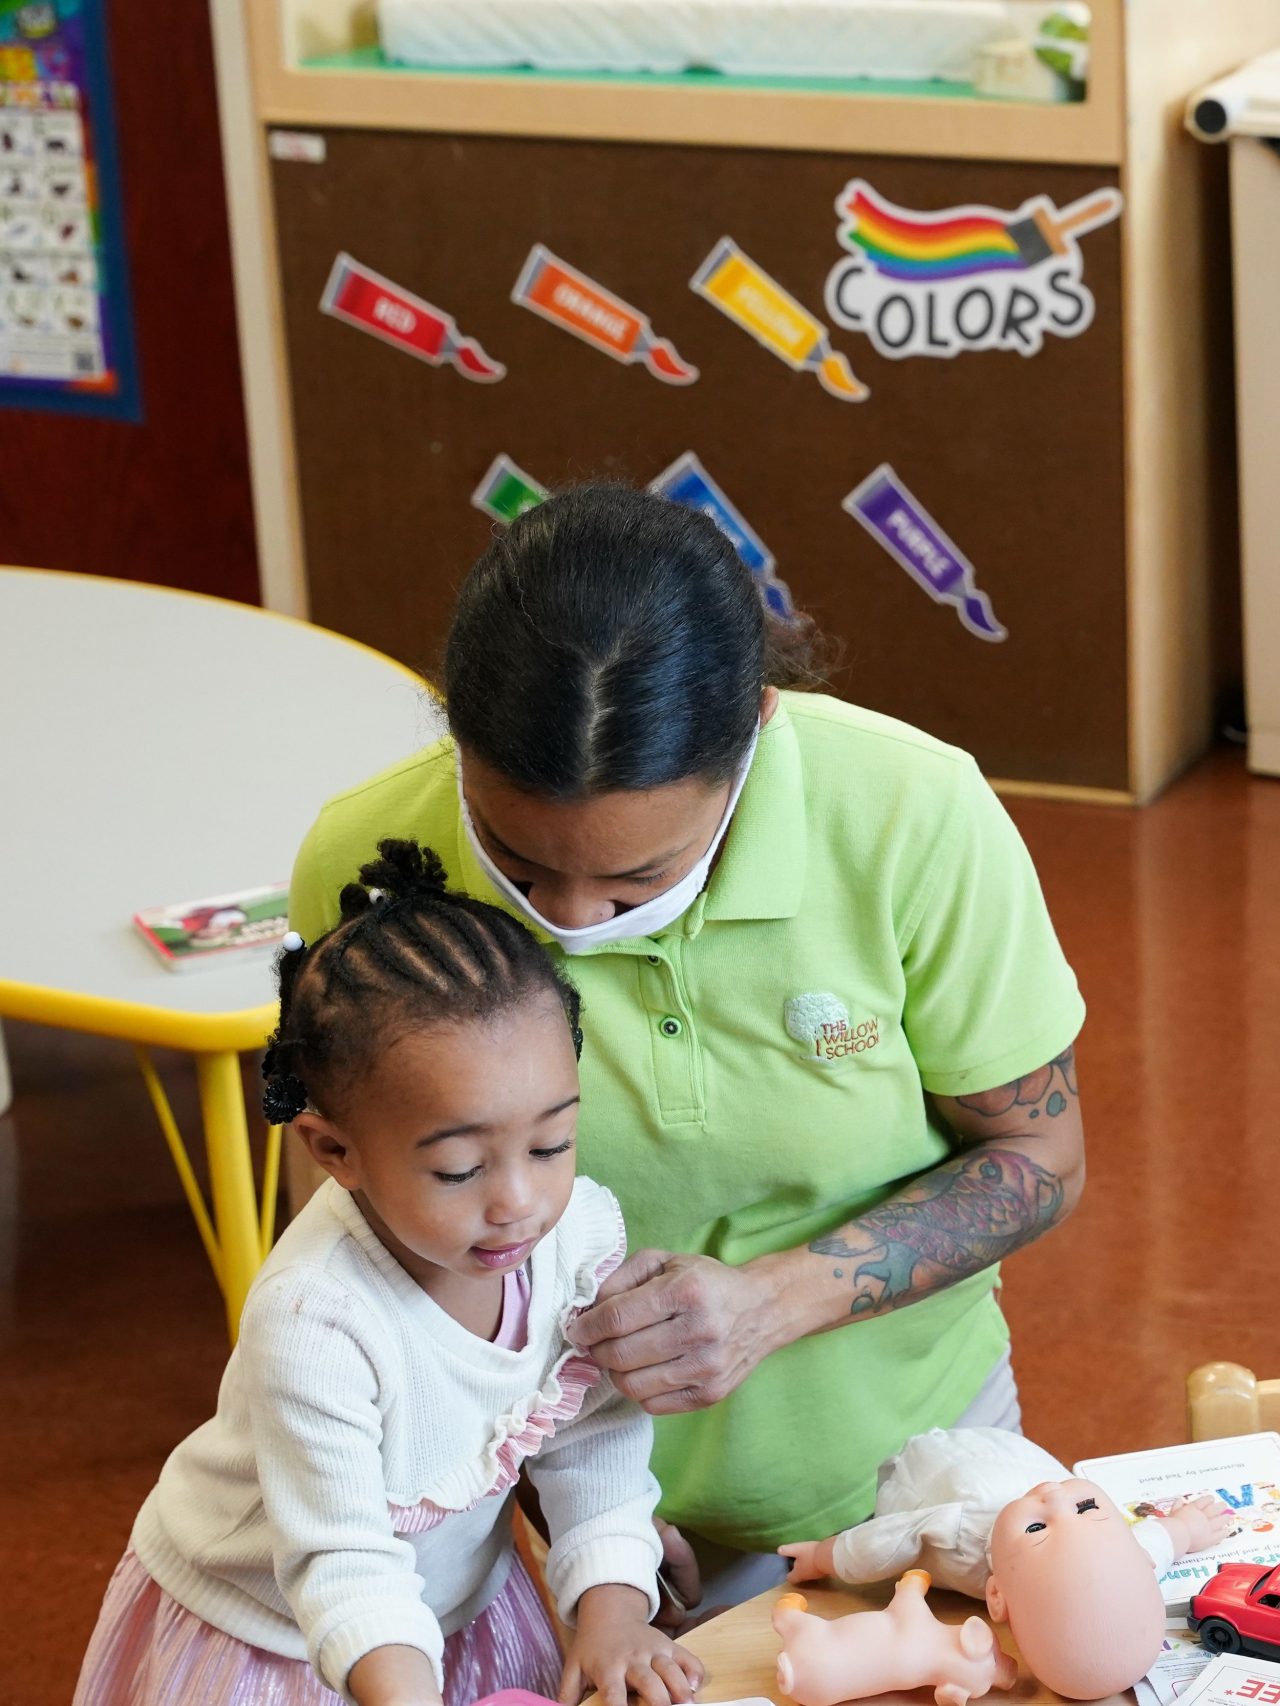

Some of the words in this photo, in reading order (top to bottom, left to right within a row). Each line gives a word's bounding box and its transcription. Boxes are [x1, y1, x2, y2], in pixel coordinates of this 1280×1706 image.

[374, 297, 416, 333] RED
[836, 266, 1084, 348] COLORS
[886, 510, 951, 579] PURPLE
[821, 1020, 847, 1035] THE
[823, 1017, 879, 1045] WILLOW
[826, 1033, 880, 1060] SCHOOL
[1218, 1550, 1239, 1559] John
